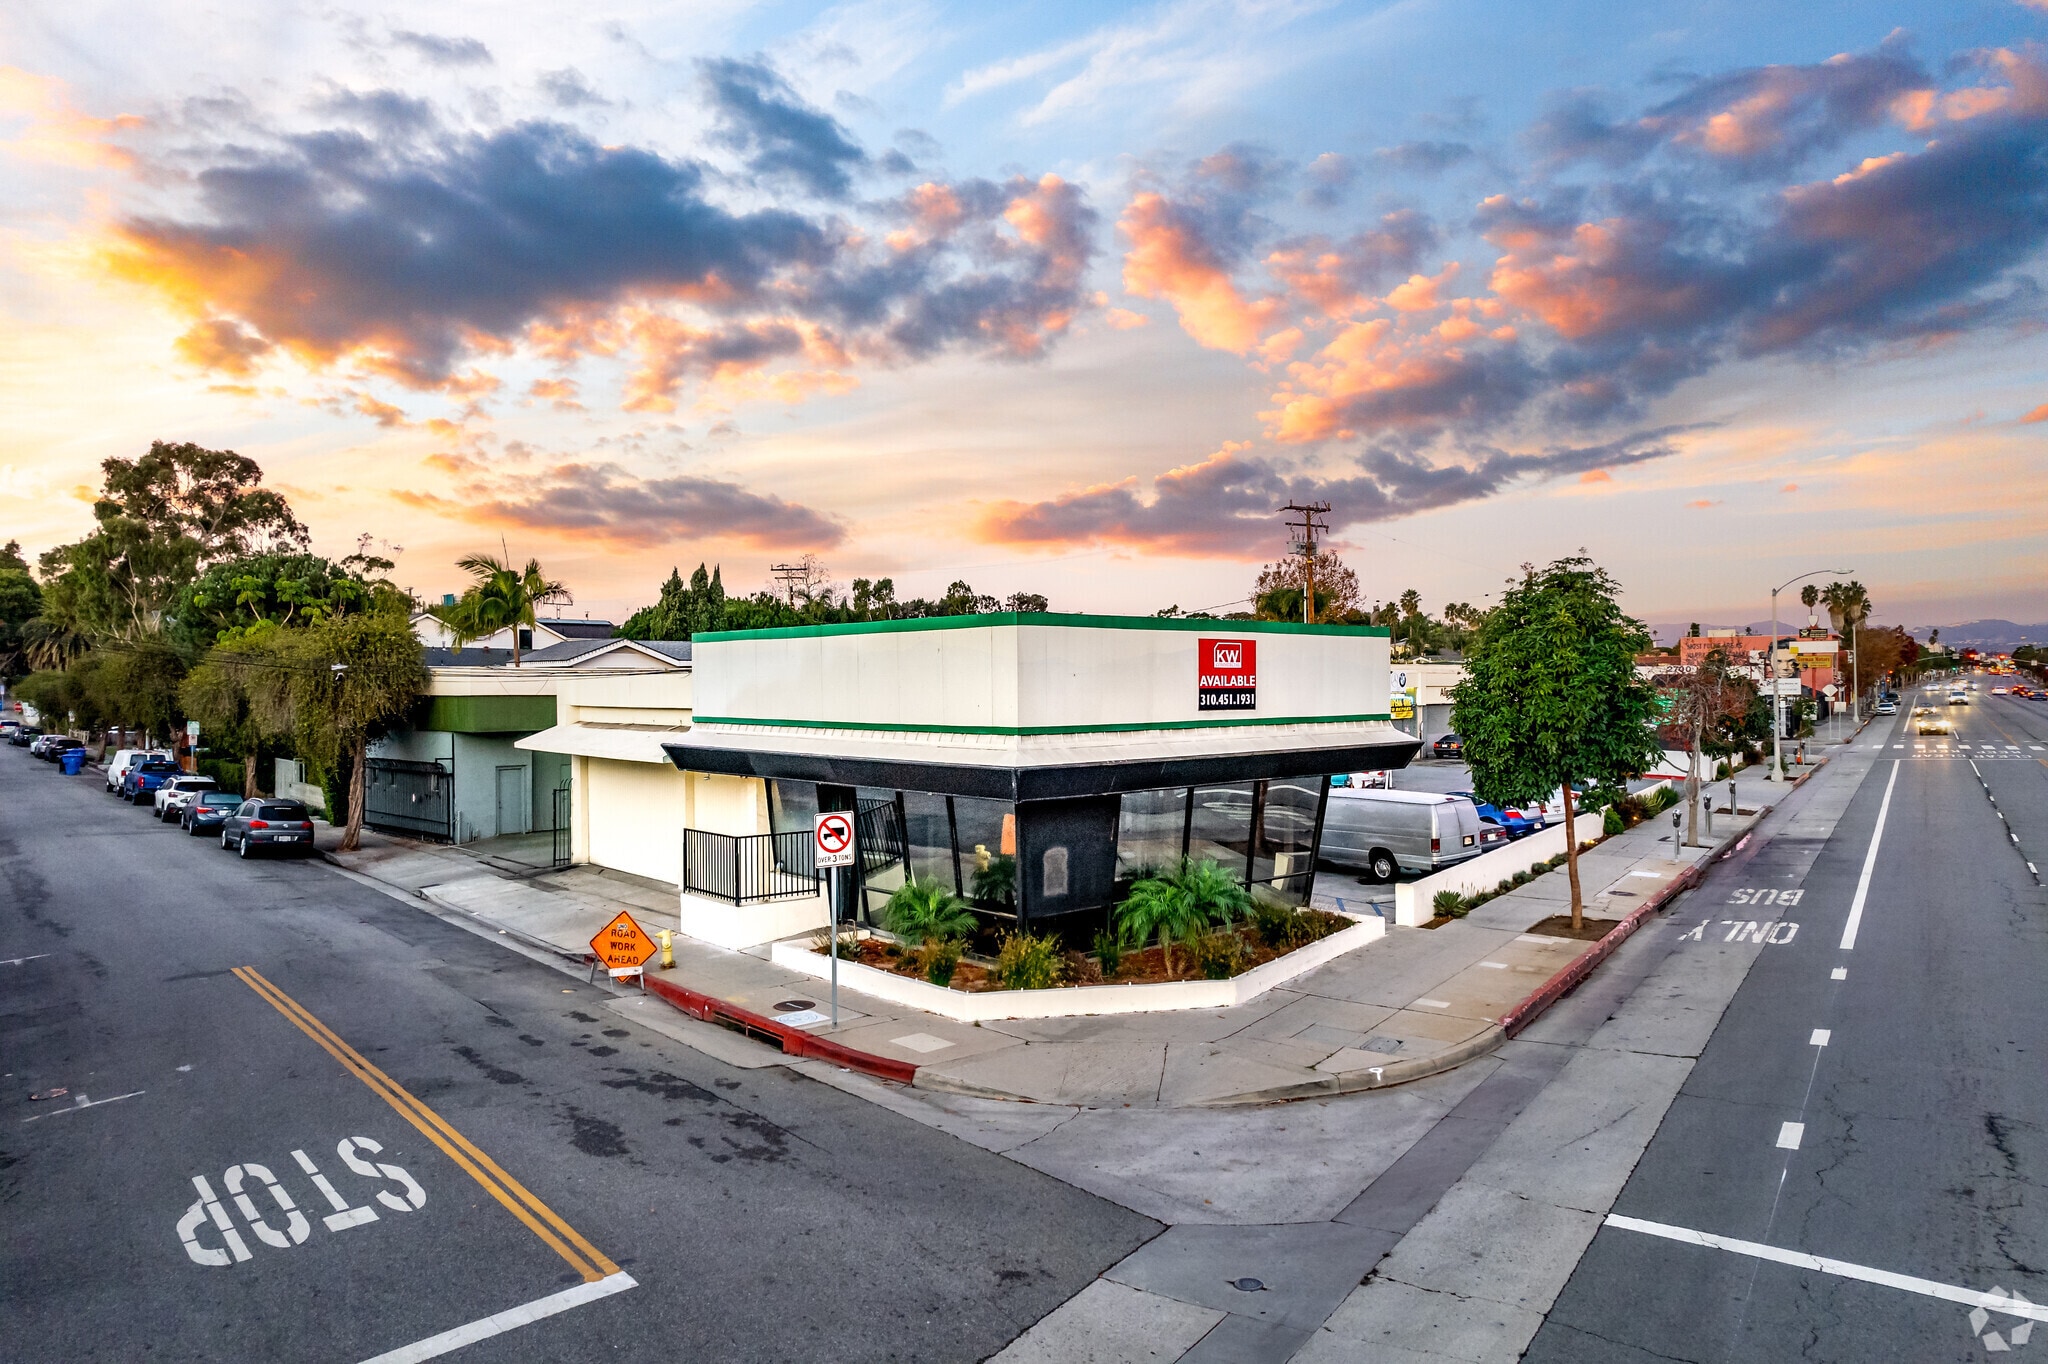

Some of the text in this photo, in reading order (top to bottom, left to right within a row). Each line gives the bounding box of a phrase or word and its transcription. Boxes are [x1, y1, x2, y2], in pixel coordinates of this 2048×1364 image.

[1216, 650, 1239, 663] KW
[1200, 675, 1256, 687] AVAILABLE
[1200, 693, 1255, 706] 310.451.1931
[832, 855, 838, 863] 3
[1726, 888, 1805, 906] BUS
[611, 929, 636, 939] ROAD
[610, 942, 636, 951] WORK
[607, 954, 639, 964] AHEAD
[176, 1136, 427, 1266] STOP
